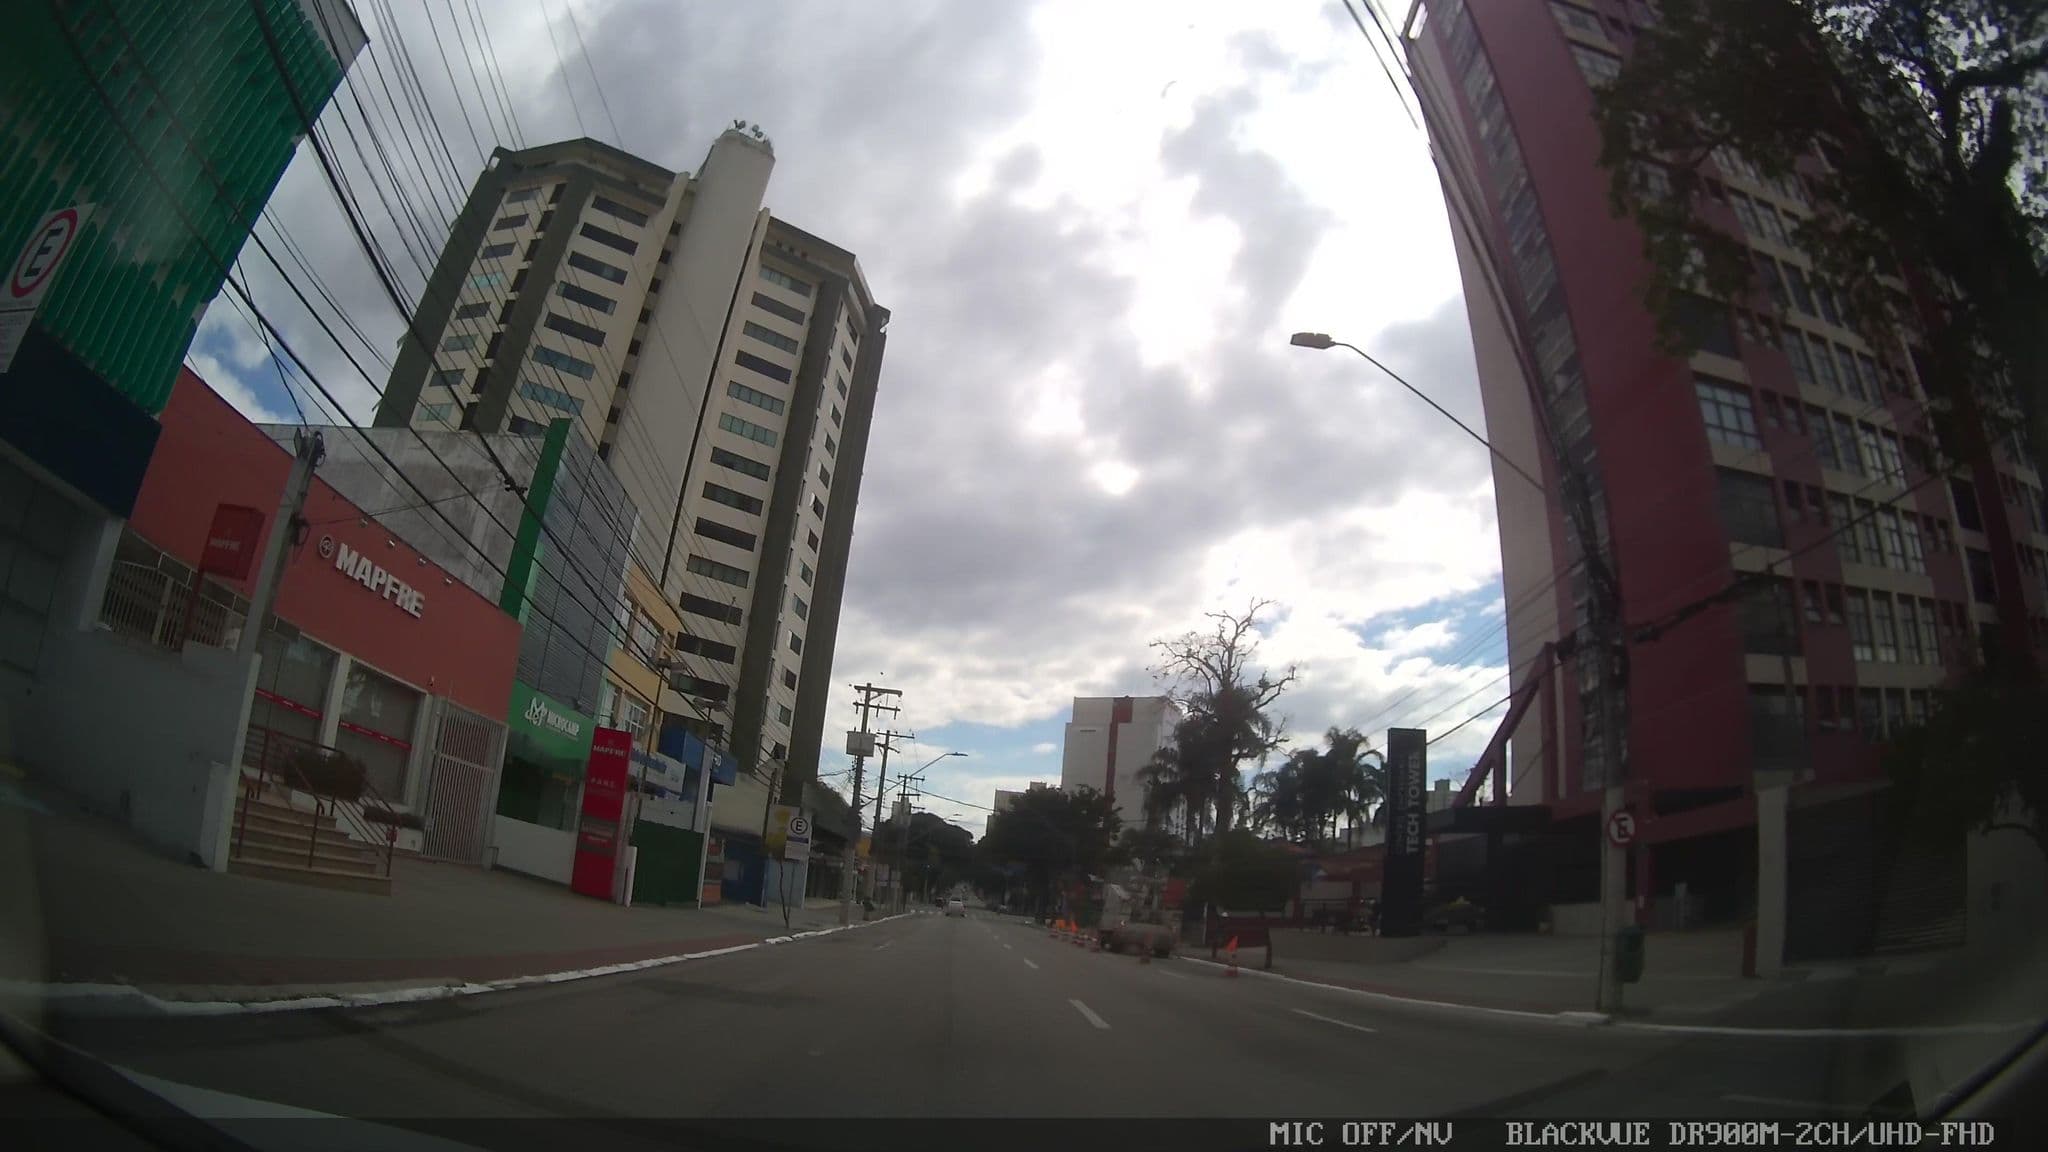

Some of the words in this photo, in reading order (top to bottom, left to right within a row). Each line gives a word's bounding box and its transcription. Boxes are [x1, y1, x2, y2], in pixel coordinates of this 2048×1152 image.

[24, 227, 64, 277] E
[335, 543, 426, 619] MAPFRE
[795, 820, 804, 832] E
[1406, 813, 1419, 855] TECH
